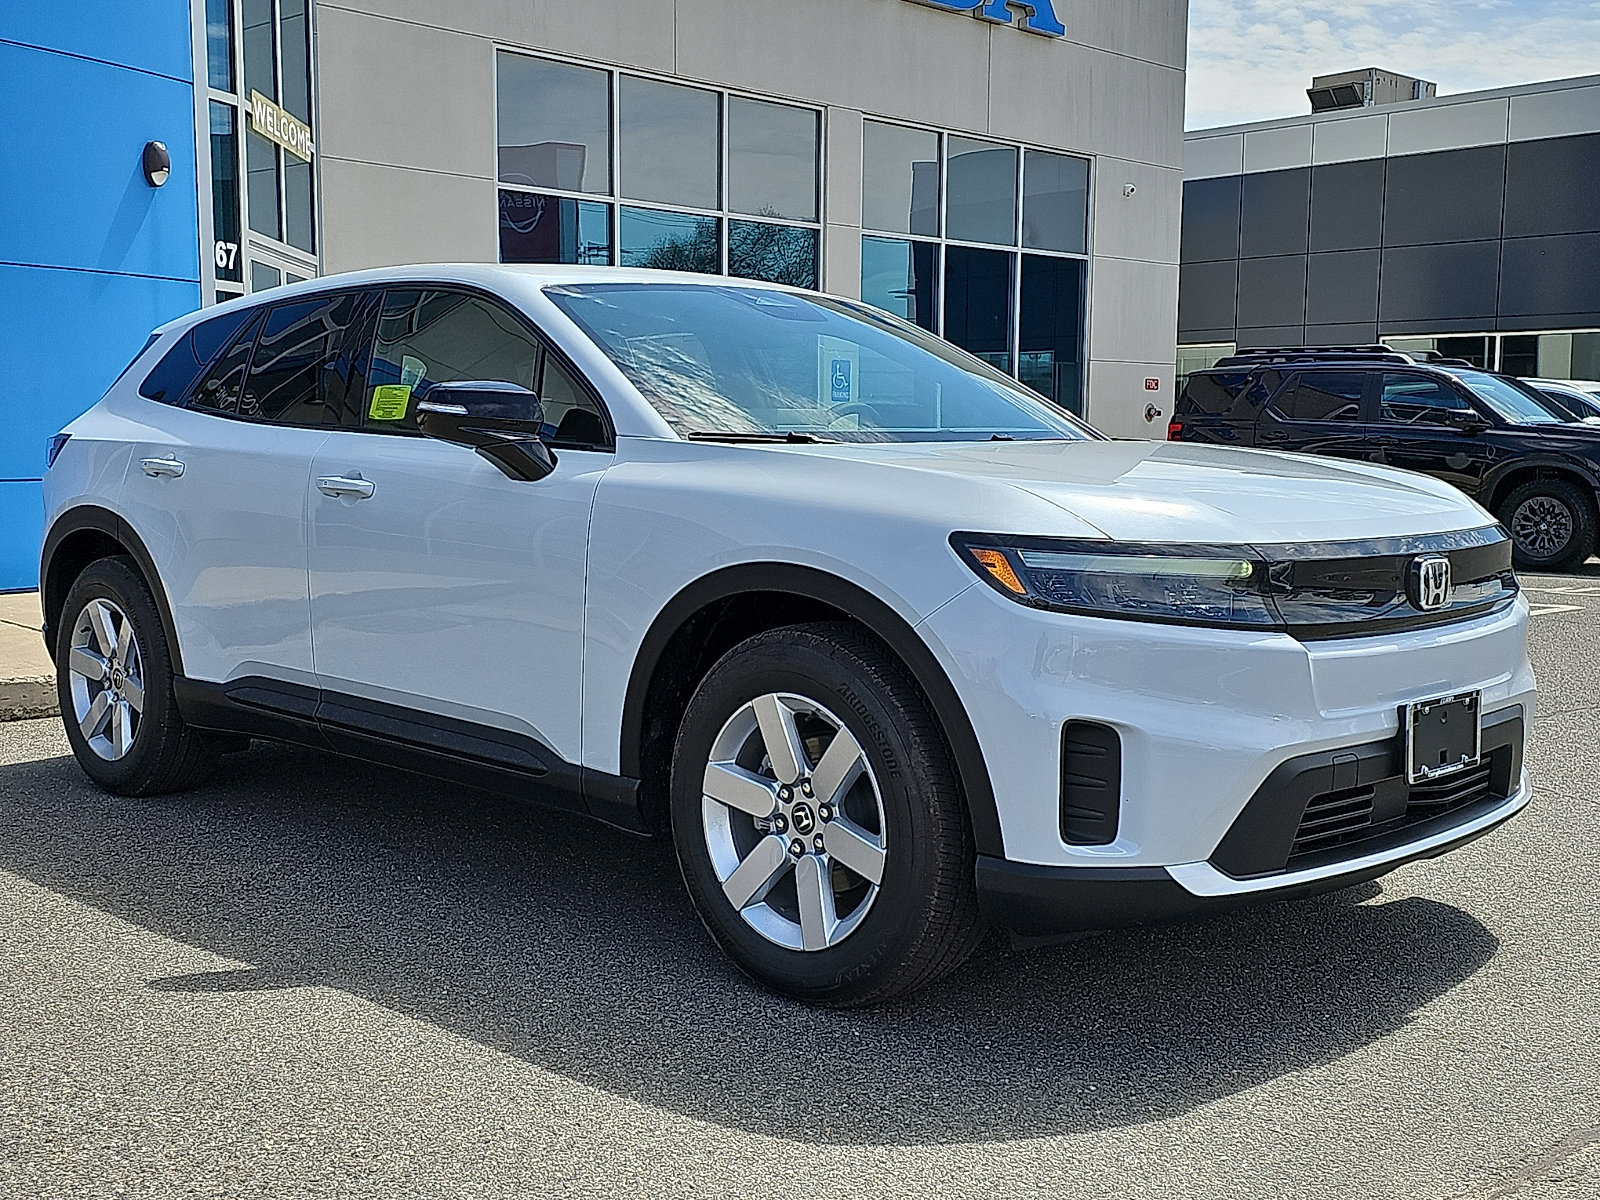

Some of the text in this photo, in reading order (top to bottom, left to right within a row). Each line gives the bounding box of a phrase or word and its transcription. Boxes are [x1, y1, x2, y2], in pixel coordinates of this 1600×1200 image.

[253, 97, 311, 157] WELCOME
[215, 240, 238, 270] 67
[1146, 379, 1158, 389] FDC
